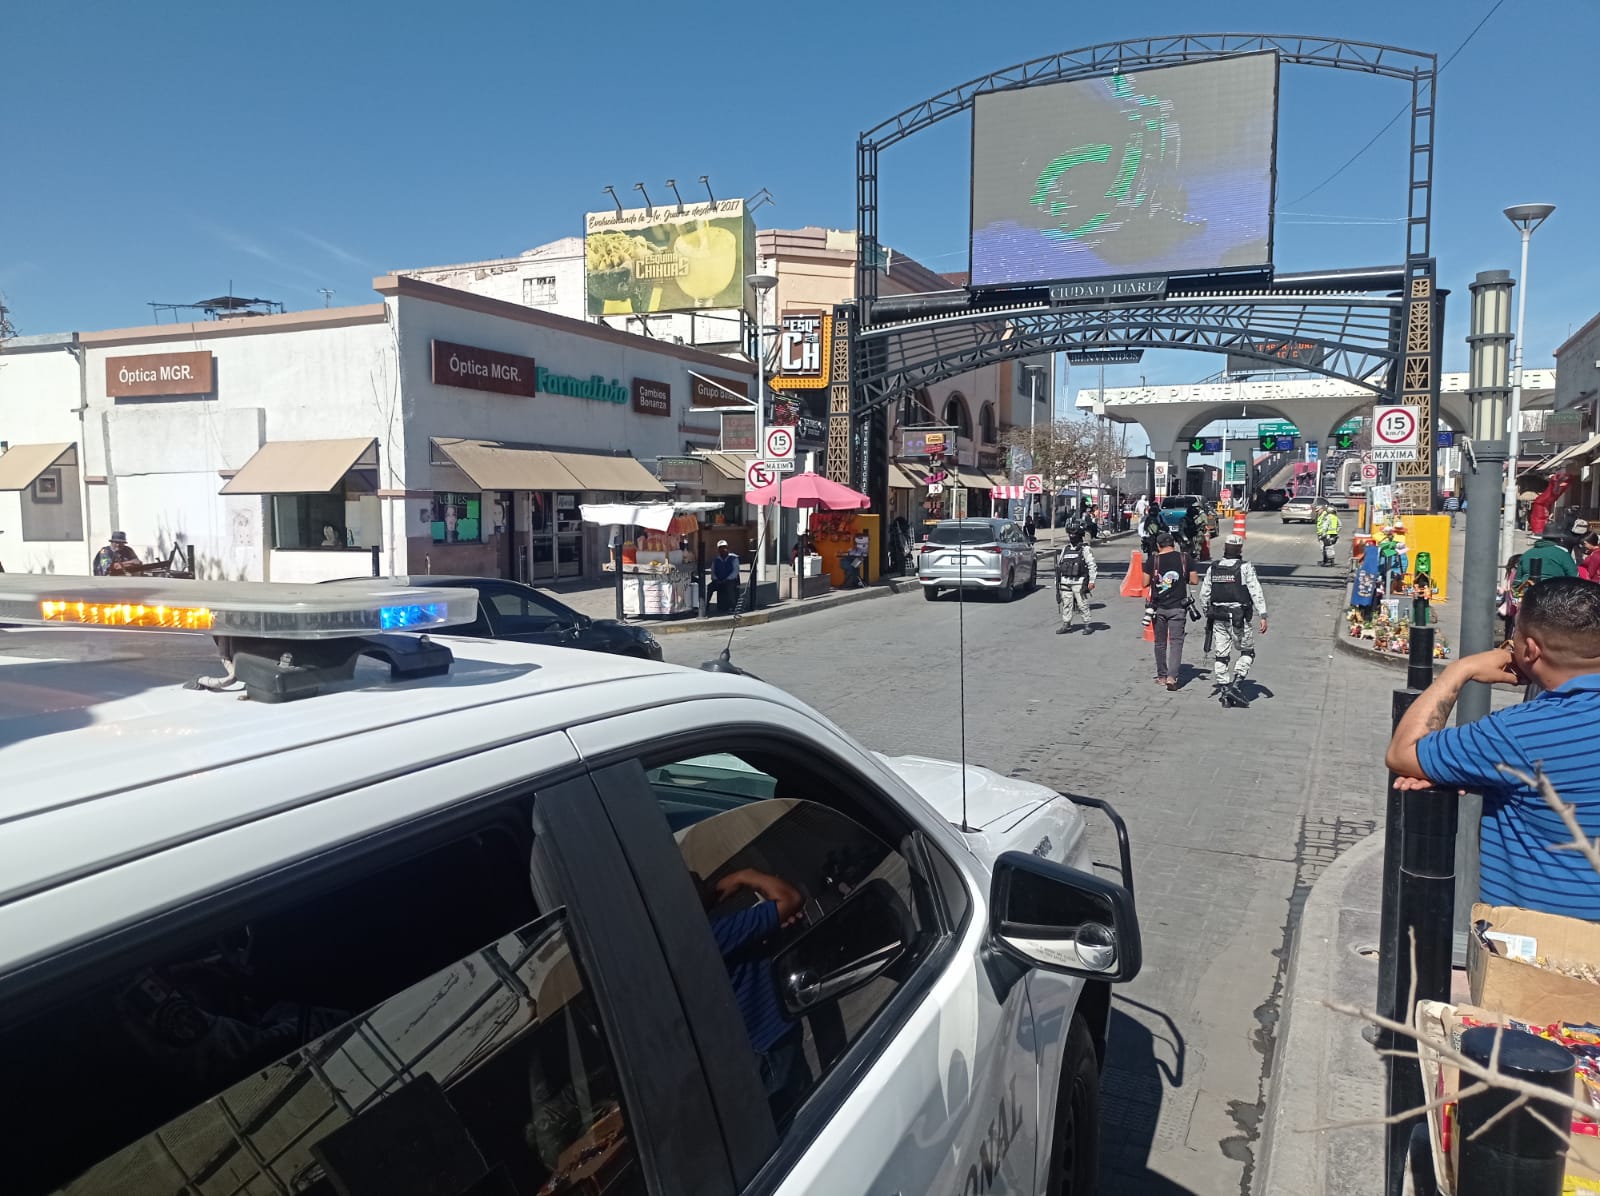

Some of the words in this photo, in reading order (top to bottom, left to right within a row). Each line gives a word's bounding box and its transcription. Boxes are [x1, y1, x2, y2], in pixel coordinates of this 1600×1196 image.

[721, 200, 740, 212] 2017
[645, 253, 678, 265] ESQUINA
[1050, 285, 1105, 298] CIUDAD
[781, 332, 820, 370] CH
[449, 353, 489, 377] Óptica
[491, 363, 522, 382] MGR.
[119, 365, 157, 386] Óptica
[159, 365, 194, 381] MGR.
[535, 366, 629, 405] Farmalivio
[639, 385, 667, 400] Cambios
[697, 383, 719, 398] Grupo
[1169, 386, 1232, 402] PUENTE
[639, 397, 667, 409] Bonanza
[1386, 417, 1405, 430] 15
[774, 436, 787, 446] 15
